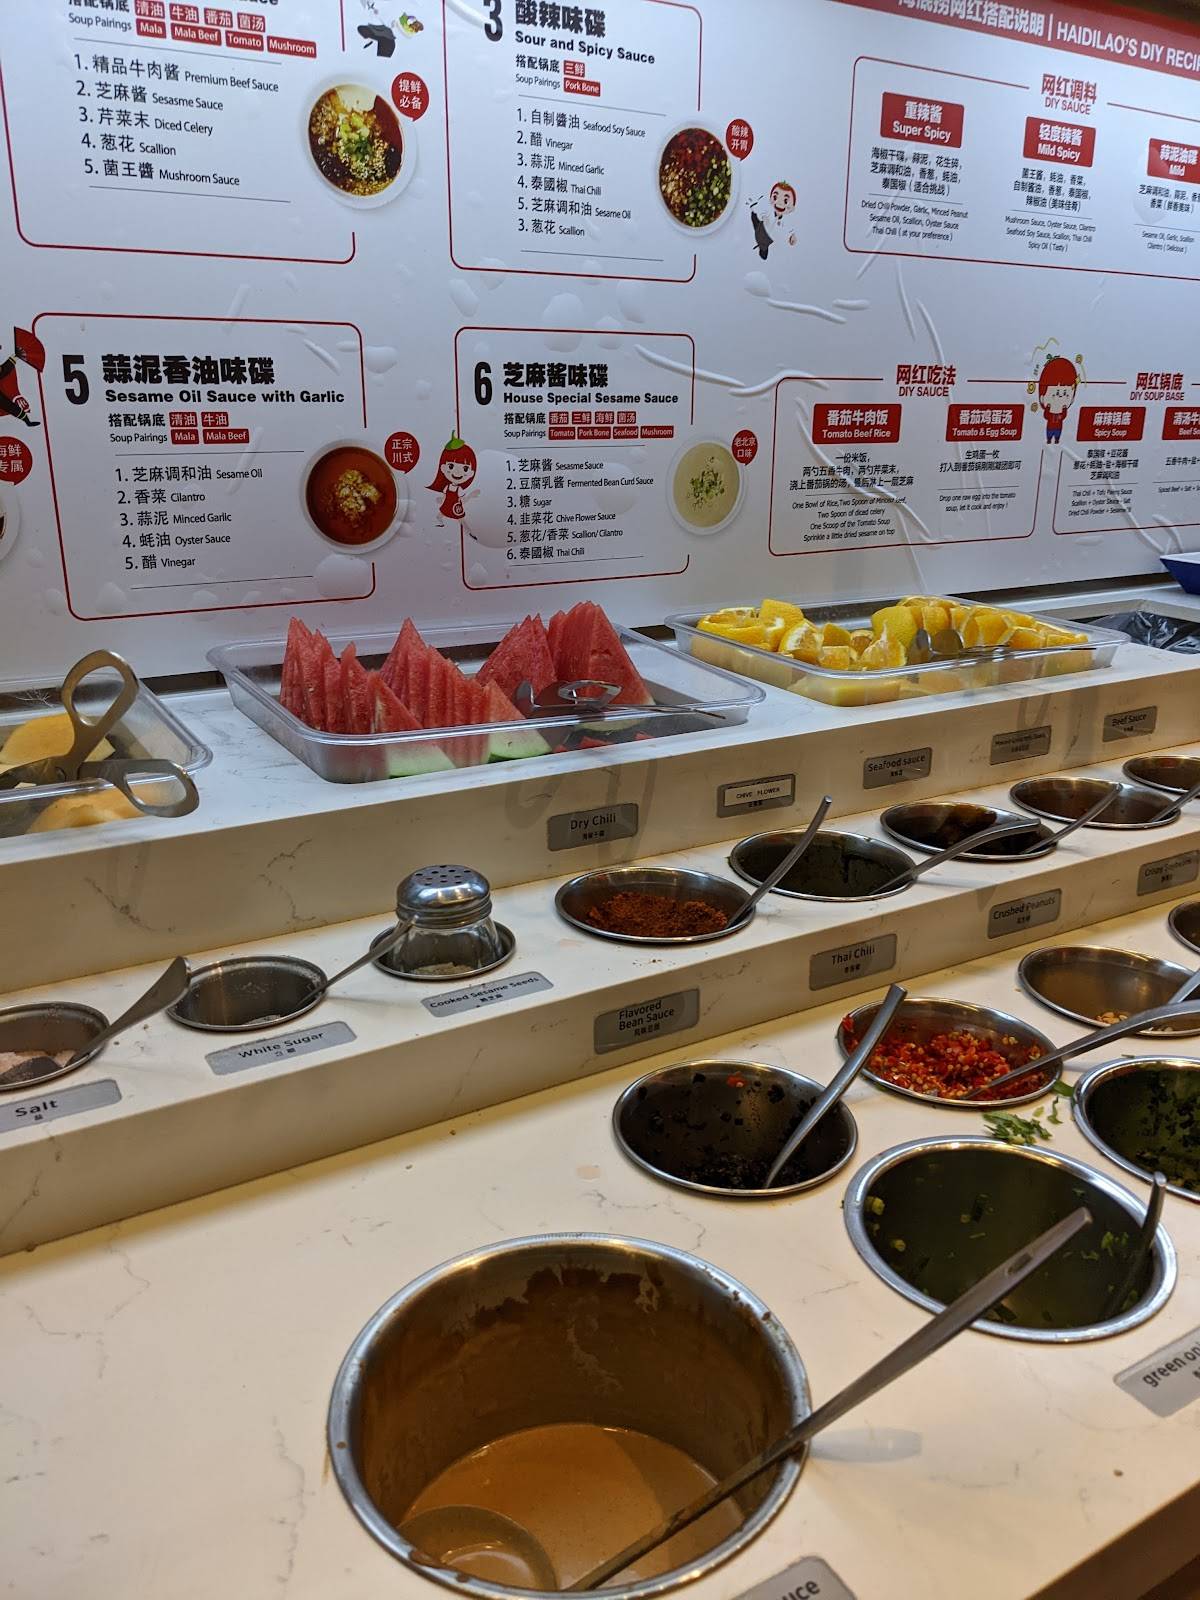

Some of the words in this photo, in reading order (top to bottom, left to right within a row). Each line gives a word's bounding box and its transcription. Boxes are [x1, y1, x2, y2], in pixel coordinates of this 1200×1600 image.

[484, 0, 503, 42] 3
[515, 0, 606, 38] 酸辣味碟
[69, 12, 93, 27] Soup
[95, 15, 132, 32] Pairings
[140, 22, 162, 35] Mala
[175, 25, 198, 38] Mala
[199, 29, 219, 41] Beef
[229, 33, 262, 47] Tomato
[269, 39, 315, 54] Mushroom
[1056, 20, 1138, 58] HAIDILAO'S
[1139, 39, 1164, 62] DIY
[515, 30, 546, 46] Sour
[550, 38, 574, 51] and
[578, 41, 613, 60] Spicy
[617, 47, 656, 64] Sauce
[74, 54, 88, 71] 1.
[92, 54, 180, 82] 精品牛肉酱
[184, 71, 228, 86] Premium
[230, 75, 251, 88] Beef
[252, 79, 279, 92] Sauce
[515, 54, 560, 74] 搭配锅底
[565, 61, 585, 77] 三鲜
[76, 80, 91, 97] 2.
[96, 81, 148, 104] 芝麻酱
[152, 93, 194, 108] Sesasme
[195, 98, 224, 111] Sauce
[398, 78, 422, 96] 提鲜
[1041, 73, 1098, 105] 网红调料
[1045, 97, 1060, 109] DIY
[1061, 99, 1091, 116] SAUCE
[79, 106, 93, 124] 3.
[98, 107, 150, 129] 芹菜末
[155, 118, 182, 132] Diced
[184, 121, 213, 136] Celery
[893, 121, 923, 137] Super
[924, 125, 952, 144] Spicy
[81, 133, 96, 150] 4.
[100, 133, 135, 153] 葱花
[139, 143, 176, 156] Scallion
[1037, 143, 1056, 156] Mild
[1057, 147, 1081, 162] Spicy
[84, 159, 99, 175] 5.
[159, 169, 211, 184] Mushroom
[212, 174, 240, 186] Sauce
[62, 354, 90, 405] 5
[101, 354, 276, 385] 蒜泥香油味碟
[502, 362, 609, 388] 芝麻酱味碟
[896, 364, 957, 386] 网红吃法
[474, 361, 493, 405] 6
[899, 387, 914, 397] DIY
[917, 387, 949, 397] SAUCE
[1135, 372, 1185, 391] 网红锅底
[105, 389, 174, 404] Sesame
[179, 388, 202, 403] Oil
[207, 389, 257, 403] Sauce
[262, 388, 295, 403] with
[300, 388, 345, 403] Garlic
[503, 392, 544, 404] House
[547, 391, 592, 406] Special
[595, 392, 641, 404] Sesame
[644, 392, 679, 404] Sauce
[1130, 391, 1143, 401] DIY
[1144, 391, 1164, 401] SOUP
[1165, 391, 1185, 401] BASE
[108, 412, 166, 428] 搭配锅底
[171, 412, 197, 427] 清油
[202, 412, 228, 427] 牛油
[827, 409, 889, 426] 番茄牛肉饭
[109, 433, 132, 445] Soup
[134, 431, 168, 445] Pairings
[174, 431, 196, 441] Mala
[206, 431, 227, 441] Mala
[228, 431, 247, 440] Beef
[822, 429, 853, 439] Tomato
[854, 429, 873, 438] Beef
[874, 429, 891, 438] Rice
[952, 428, 979, 437] Tomato
[986, 428, 999, 438] Egg
[1000, 427, 1018, 438] Soup
[1094, 428, 1111, 439] Spicy
[1111, 428, 1128, 439] Soup
[391, 439, 412, 451] 正宗
[392, 452, 413, 464] 川式
[115, 468, 129, 482] 1.
[133, 465, 212, 482] 芝麻调和油
[216, 469, 250, 479] Sesame
[251, 468, 263, 478] Oil
[117, 490, 131, 504] 2.
[135, 489, 167, 505] 香菜
[170, 492, 206, 503] Cilantro
[119, 512, 133, 526] 3.
[137, 510, 169, 526] 蒜泥
[173, 512, 206, 524] Minced
[207, 512, 232, 523] Garlic
[122, 534, 136, 548] 4.
[139, 532, 171, 548] 蚝油
[175, 535, 203, 547] Oyster
[205, 534, 231, 544] Sauce
[125, 556, 138, 570] 5.
[141, 553, 157, 570] 醋
[160, 557, 196, 569] Vinegar
[868, 758, 902, 773] Seafood
[903, 754, 926, 766] sauce
[570, 819, 590, 831] Dry
[592, 812, 617, 827] Chili
[993, 902, 1025, 920] Crushed
[1026, 896, 1056, 912] Peanuts
[831, 950, 853, 966] Thai
[854, 945, 875, 960] Chili
[430, 994, 469, 1009] Cooked
[470, 984, 508, 999] Sesame
[509, 976, 540, 989] Seeds
[618, 999, 662, 1020] Flavored
[618, 1017, 643, 1031] Bean
[646, 1007, 675, 1023] Sauce
[238, 1044, 281, 1059] White
[284, 1032, 324, 1048] Sugar
[15, 1099, 58, 1118] Salt
[1142, 1356, 1188, 1388] green
